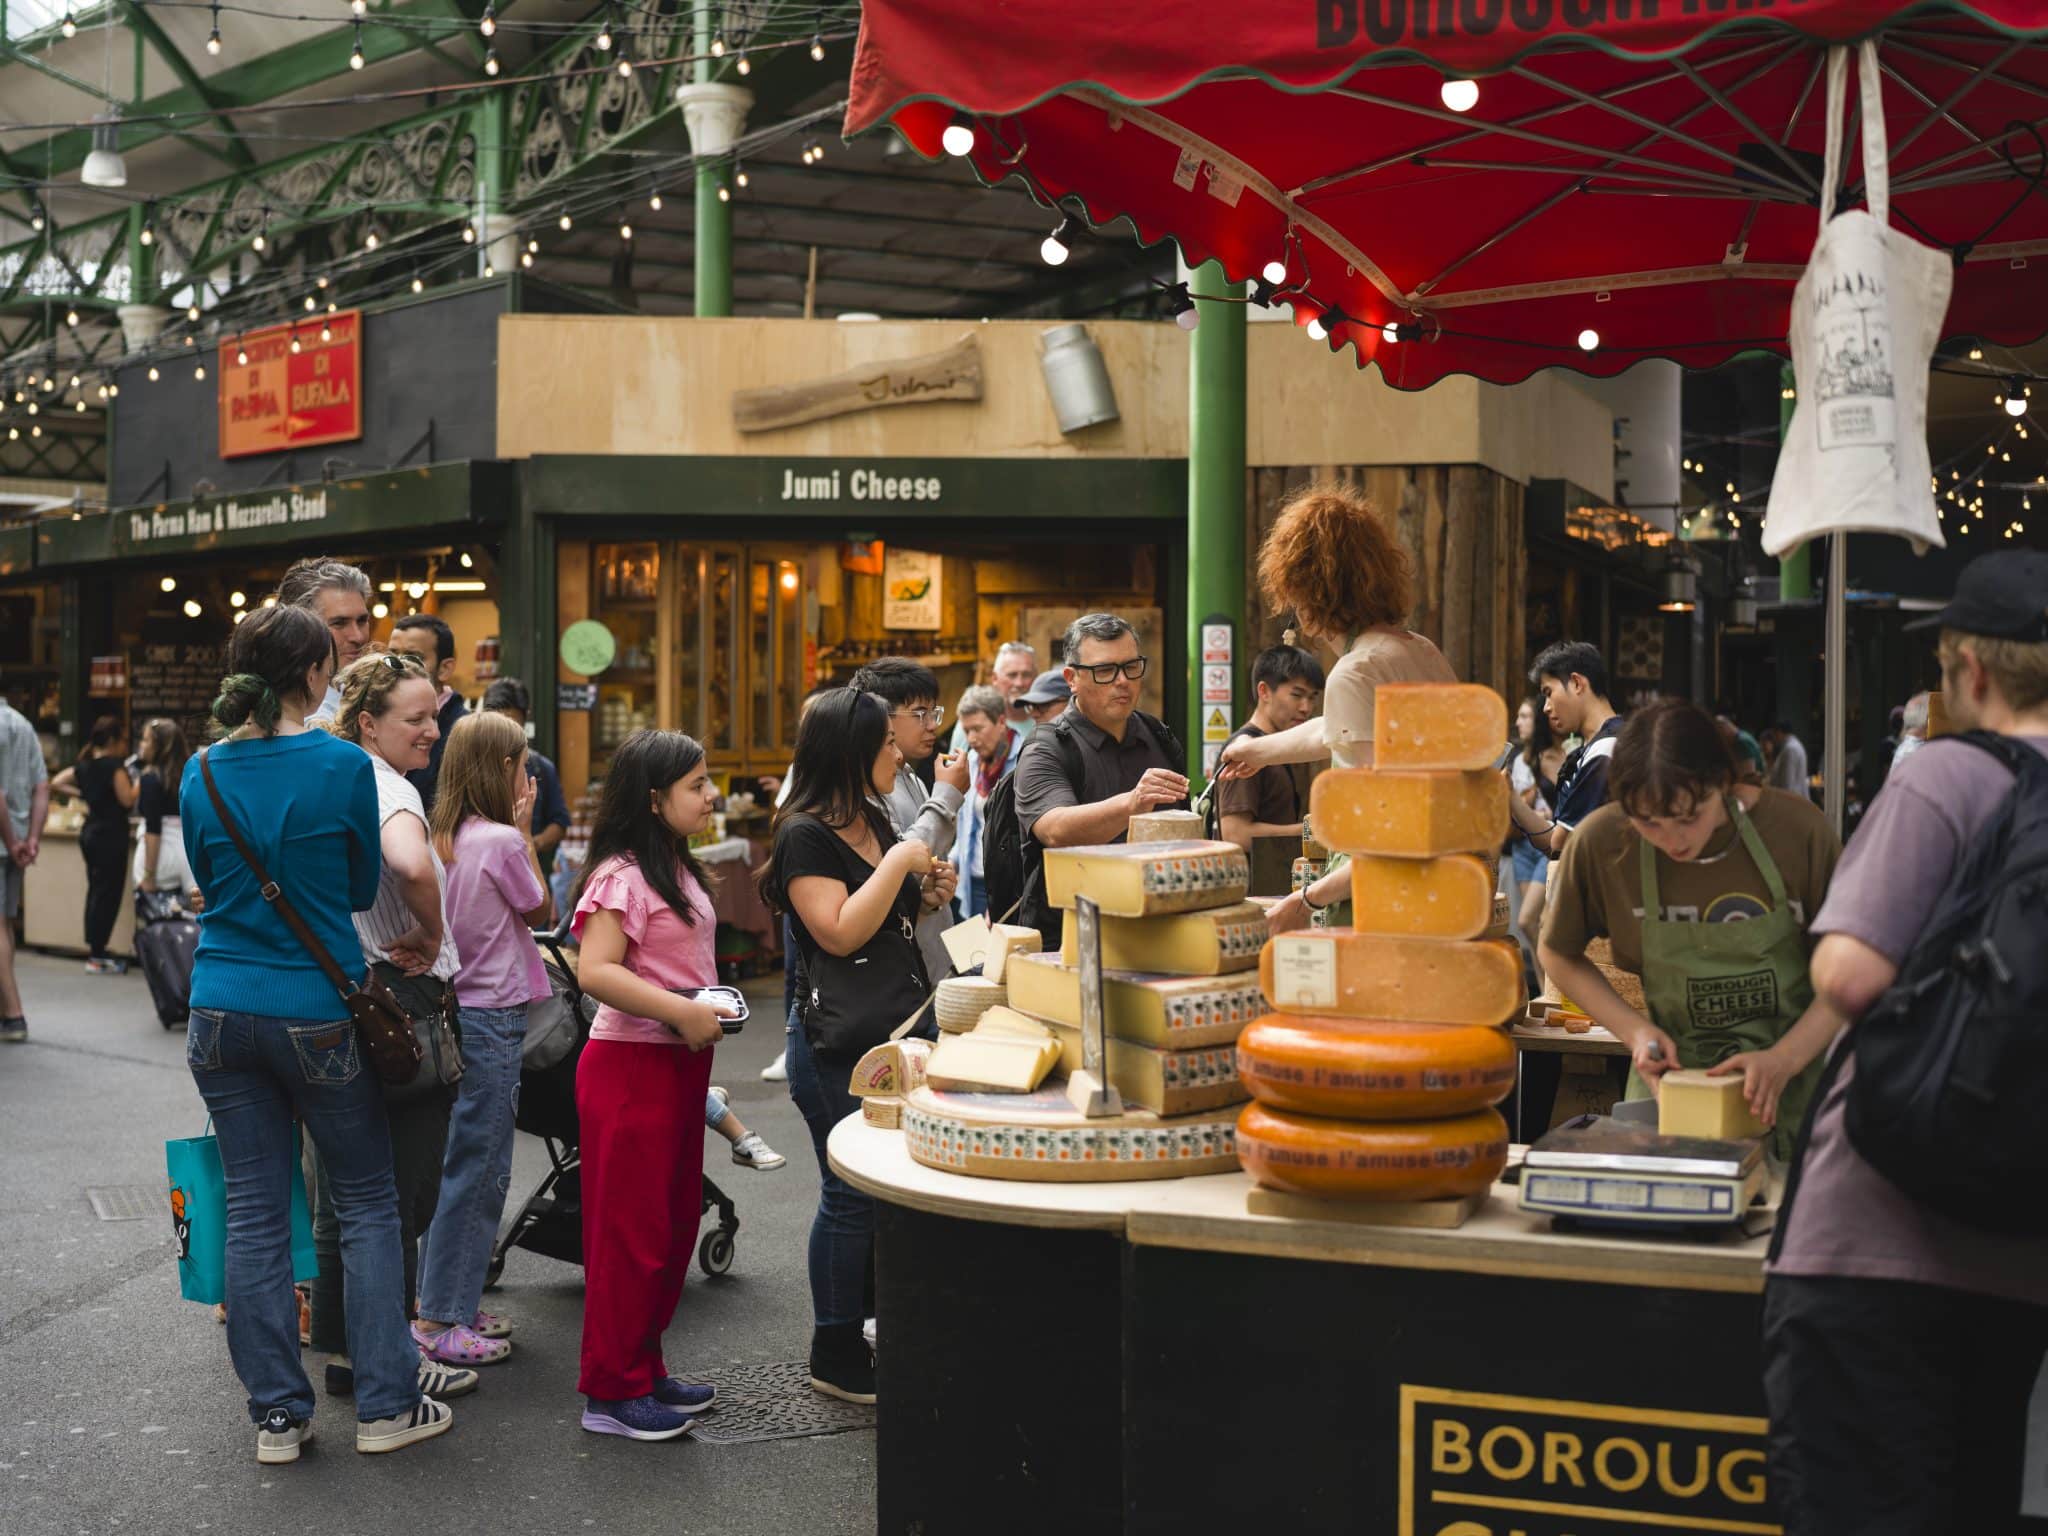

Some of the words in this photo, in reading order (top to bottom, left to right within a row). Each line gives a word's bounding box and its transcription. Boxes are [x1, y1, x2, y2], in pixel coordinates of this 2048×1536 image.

[291, 379, 350, 413] BUFALA
[781, 469, 840, 500] Jumi
[850, 469, 941, 500] Cheese
[131, 514, 149, 540] The
[152, 511, 184, 538] Parma
[187, 507, 212, 534] Ham
[214, 503, 224, 531] &
[227, 496, 288, 529] Mozzarella
[291, 490, 326, 522] Stand
[1691, 974, 1771, 993] BOROUGH
[1694, 992, 1772, 1011] CHEESE
[1314, 1070, 1406, 1088] l'amuse
[1340, 1151, 1430, 1168] l'amuse
[1432, 1419, 1767, 1504] BOROUG
